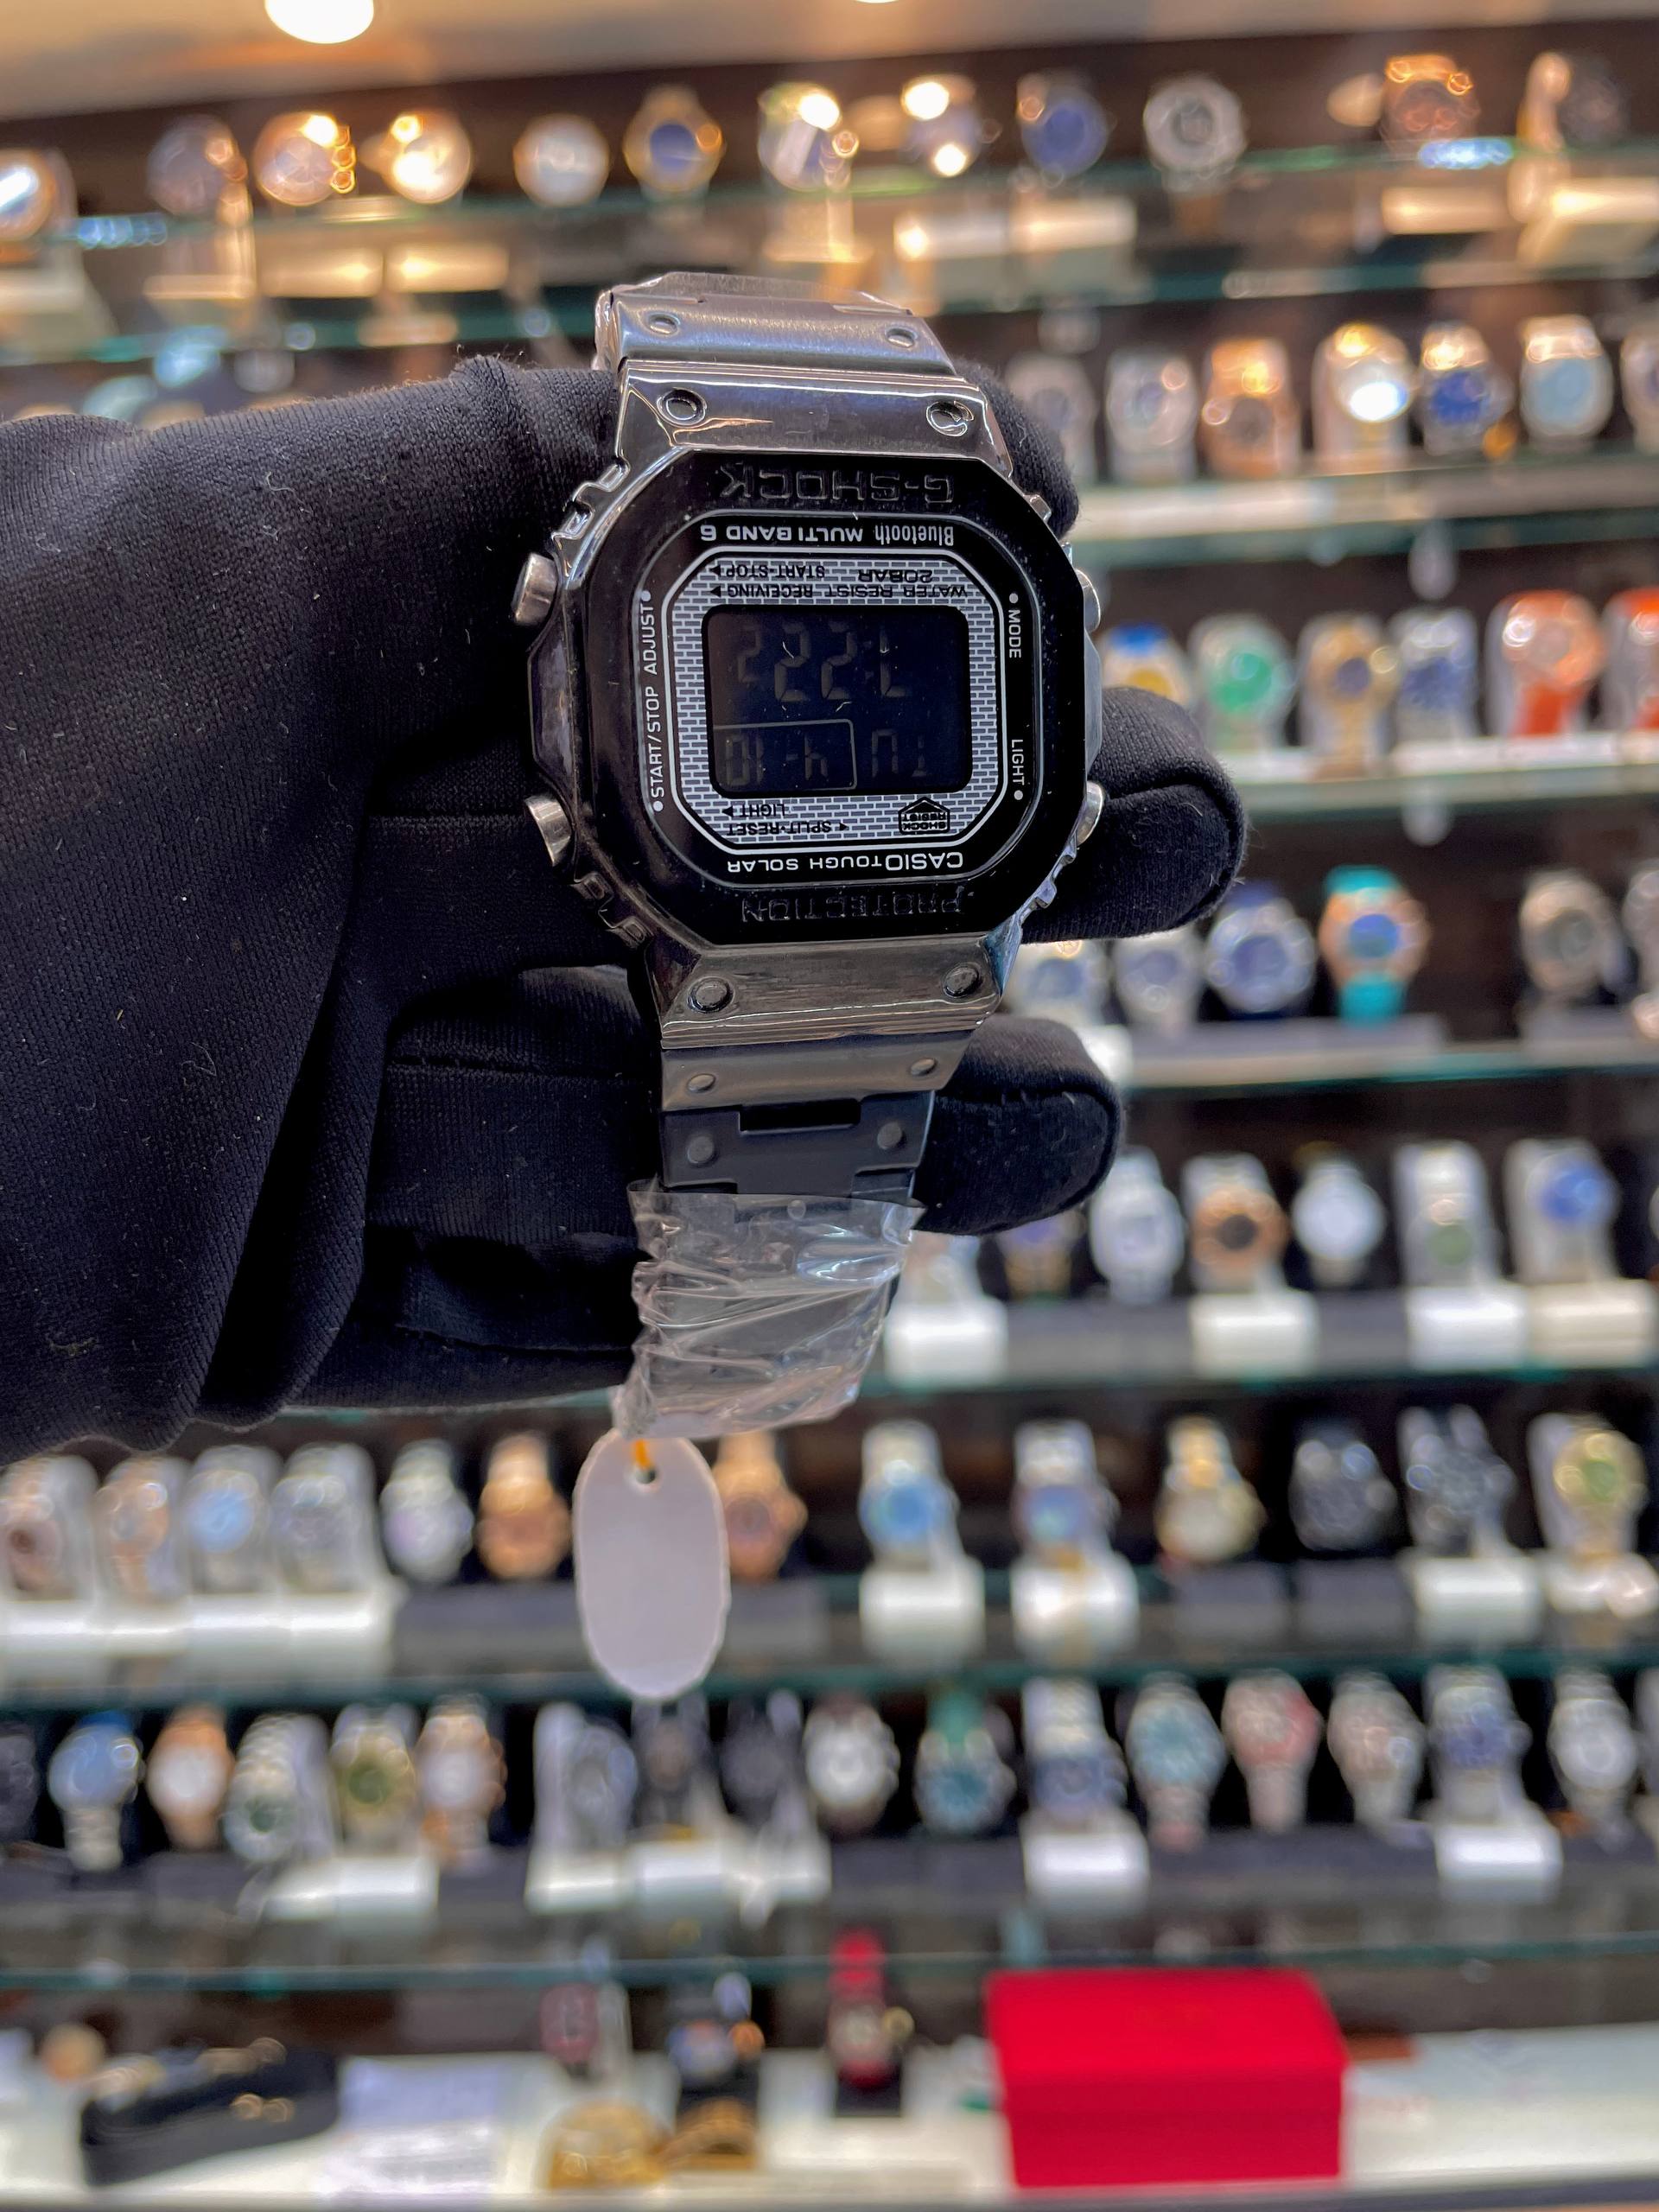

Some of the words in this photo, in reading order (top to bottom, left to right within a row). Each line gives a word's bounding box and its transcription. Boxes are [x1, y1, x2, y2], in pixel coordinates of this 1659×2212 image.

[719, 462, 954, 504] G-SHOCK
[700, 524, 717, 541] 6
[726, 524, 792, 541] BAND
[798, 525, 863, 542] MULTI
[874, 524, 954, 546] Bluetooth
[858, 569, 933, 583] 20BAR
[727, 583, 813, 598] RECEIVING
[824, 584, 893, 598] RESIST
[903, 584, 969, 598] WATER
[639, 603, 658, 675] ADJUST
[1007, 609, 1022, 658] MODE
[645, 686, 664, 798] START/STOP
[1011, 739, 1025, 785] LIGHT
[739, 804, 785, 817] LIGHT
[903, 812, 947, 821] RESIST
[903, 821, 947, 830] SHOCK
[727, 857, 799, 873] SOLAR
[810, 855, 882, 870] TOUGH
[885, 851, 963, 871] CASIO
[741, 892, 963, 923] PROTECTION
